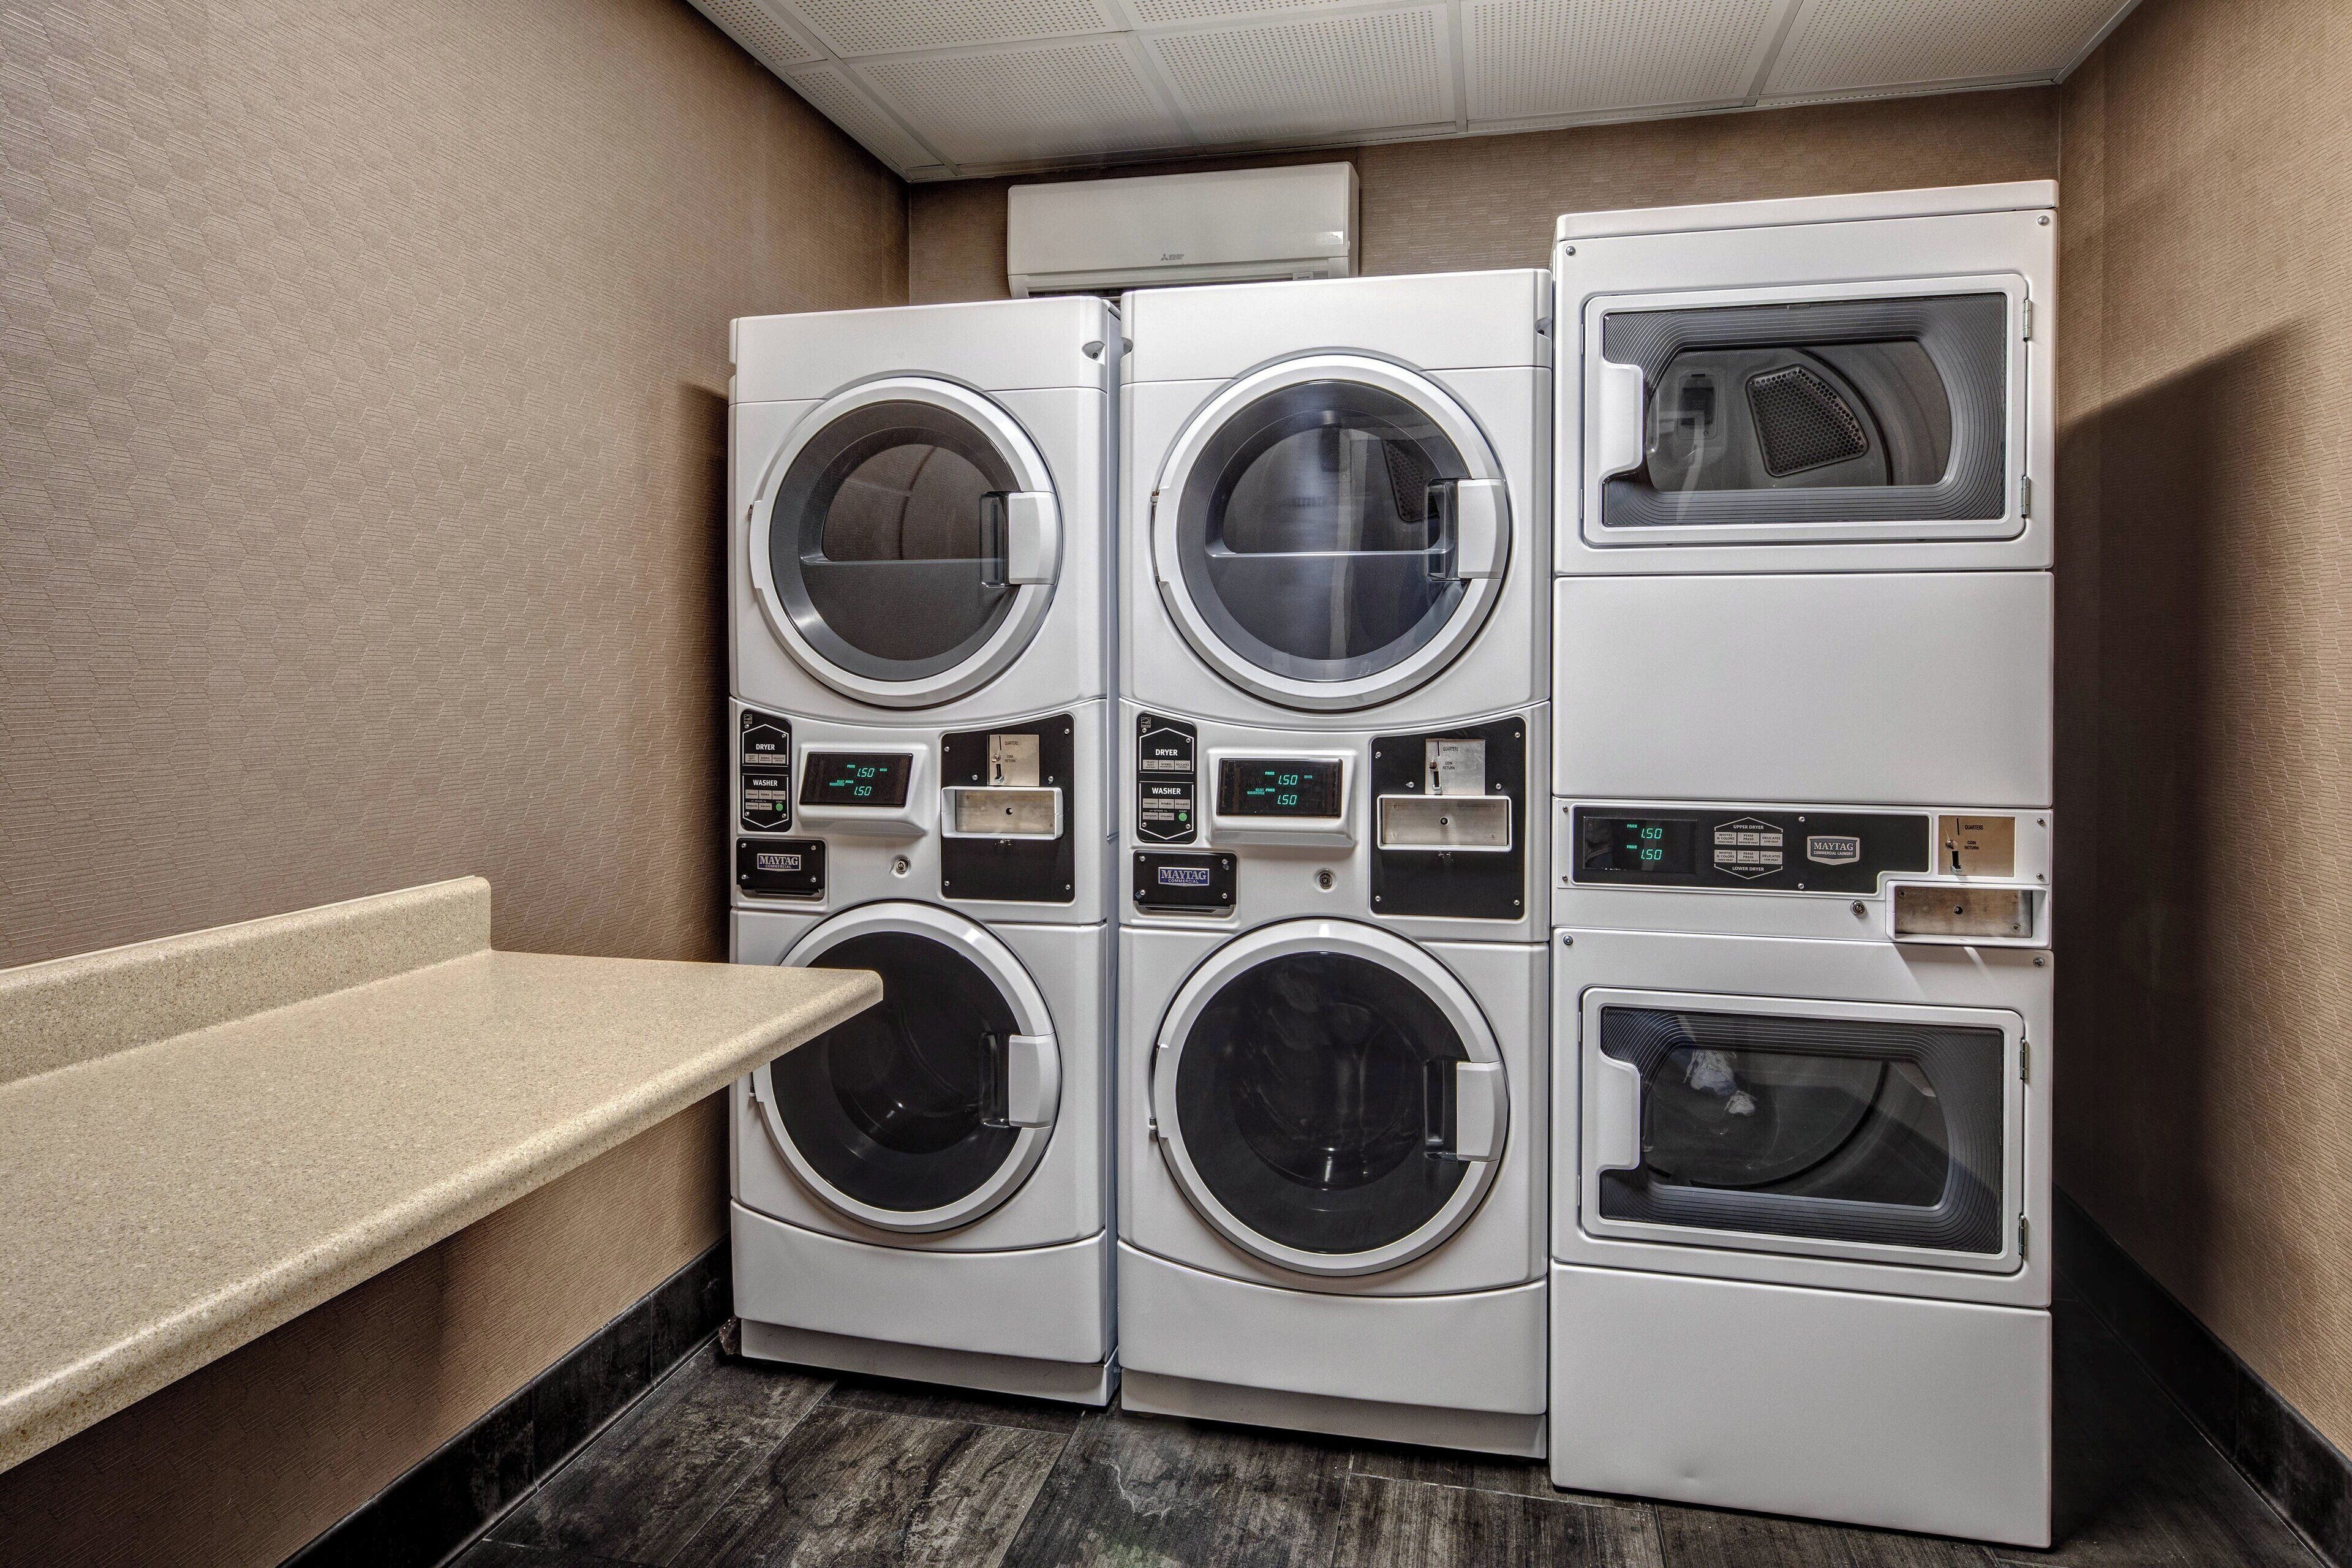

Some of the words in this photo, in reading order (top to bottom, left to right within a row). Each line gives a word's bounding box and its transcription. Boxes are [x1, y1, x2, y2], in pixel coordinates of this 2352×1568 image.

[857, 767, 875, 777] 1.50
[1278, 775, 1298, 785] 1.50
[854, 786, 872, 796] 1.50
[1278, 795, 1297, 805] 1.50
[1642, 828, 1662, 839] 1.50
[1814, 842, 1853, 851] MAYTAG
[1641, 849, 1662, 860] 1.50
[760, 856, 798, 865] MAYTAG
[1161, 870, 1207, 880] MAYTAG
